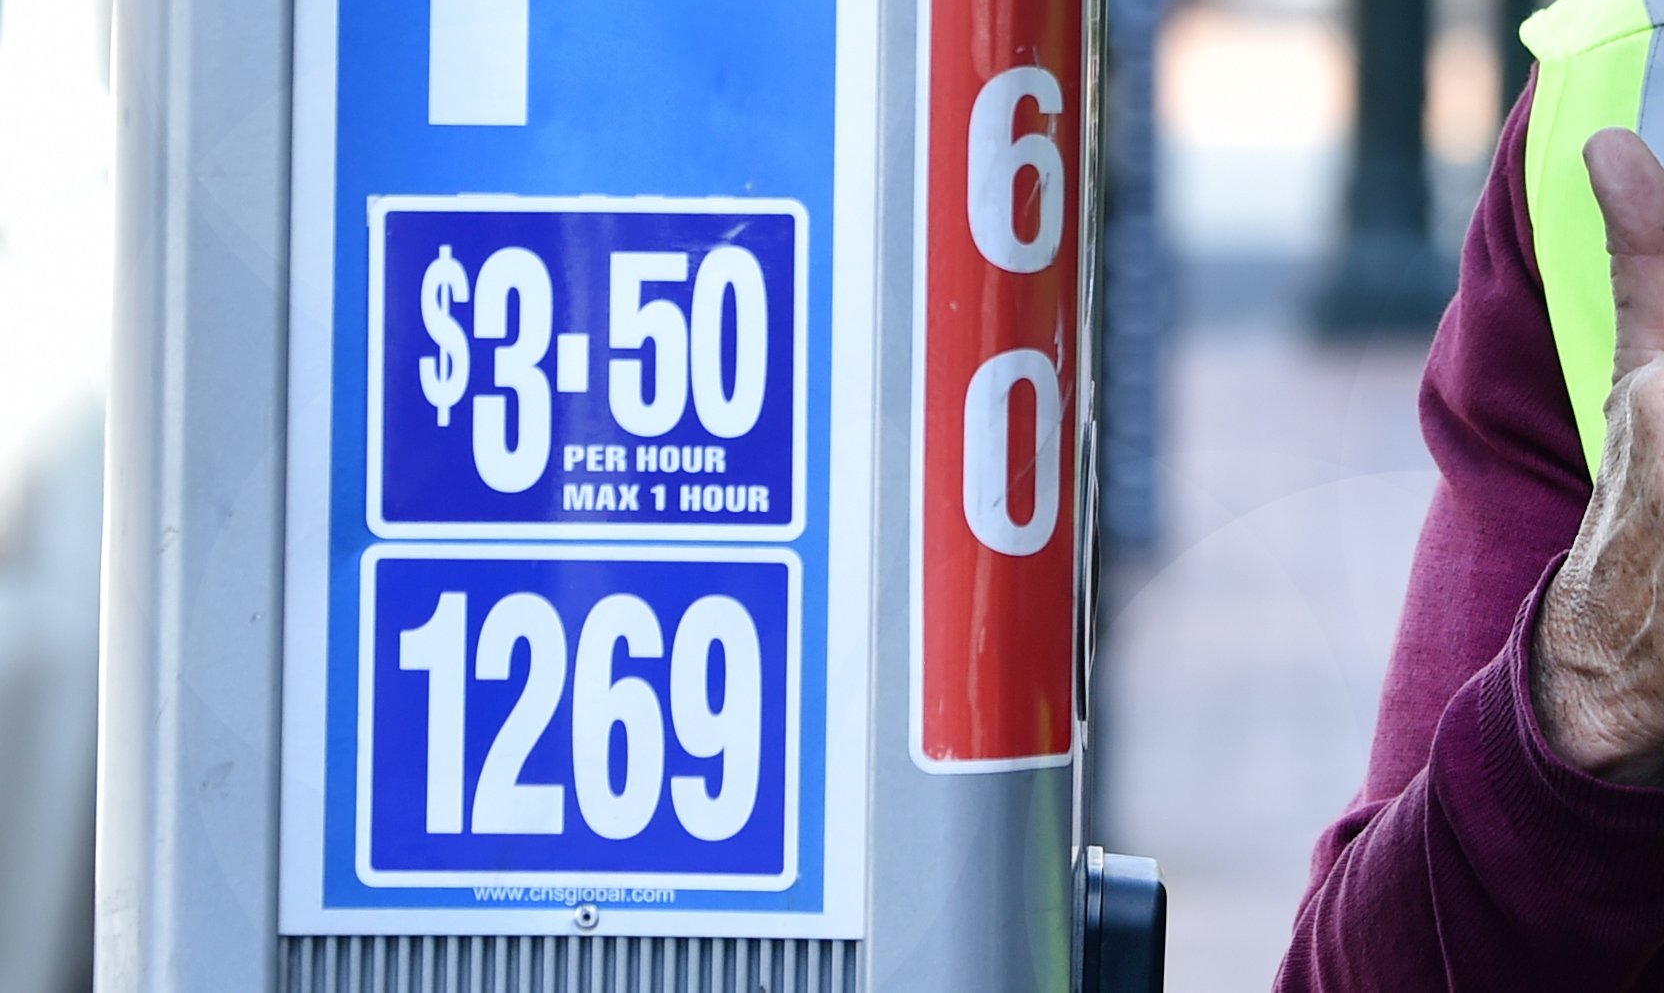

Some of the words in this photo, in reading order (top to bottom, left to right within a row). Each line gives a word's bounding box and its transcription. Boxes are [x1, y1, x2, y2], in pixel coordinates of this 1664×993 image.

[563, 444, 627, 472] PER
[636, 445, 726, 474] HOUR
[562, 483, 640, 511] MAX
[650, 483, 666, 512] 1
[680, 484, 769, 513] HOUR
[399, 591, 763, 842] 1269
